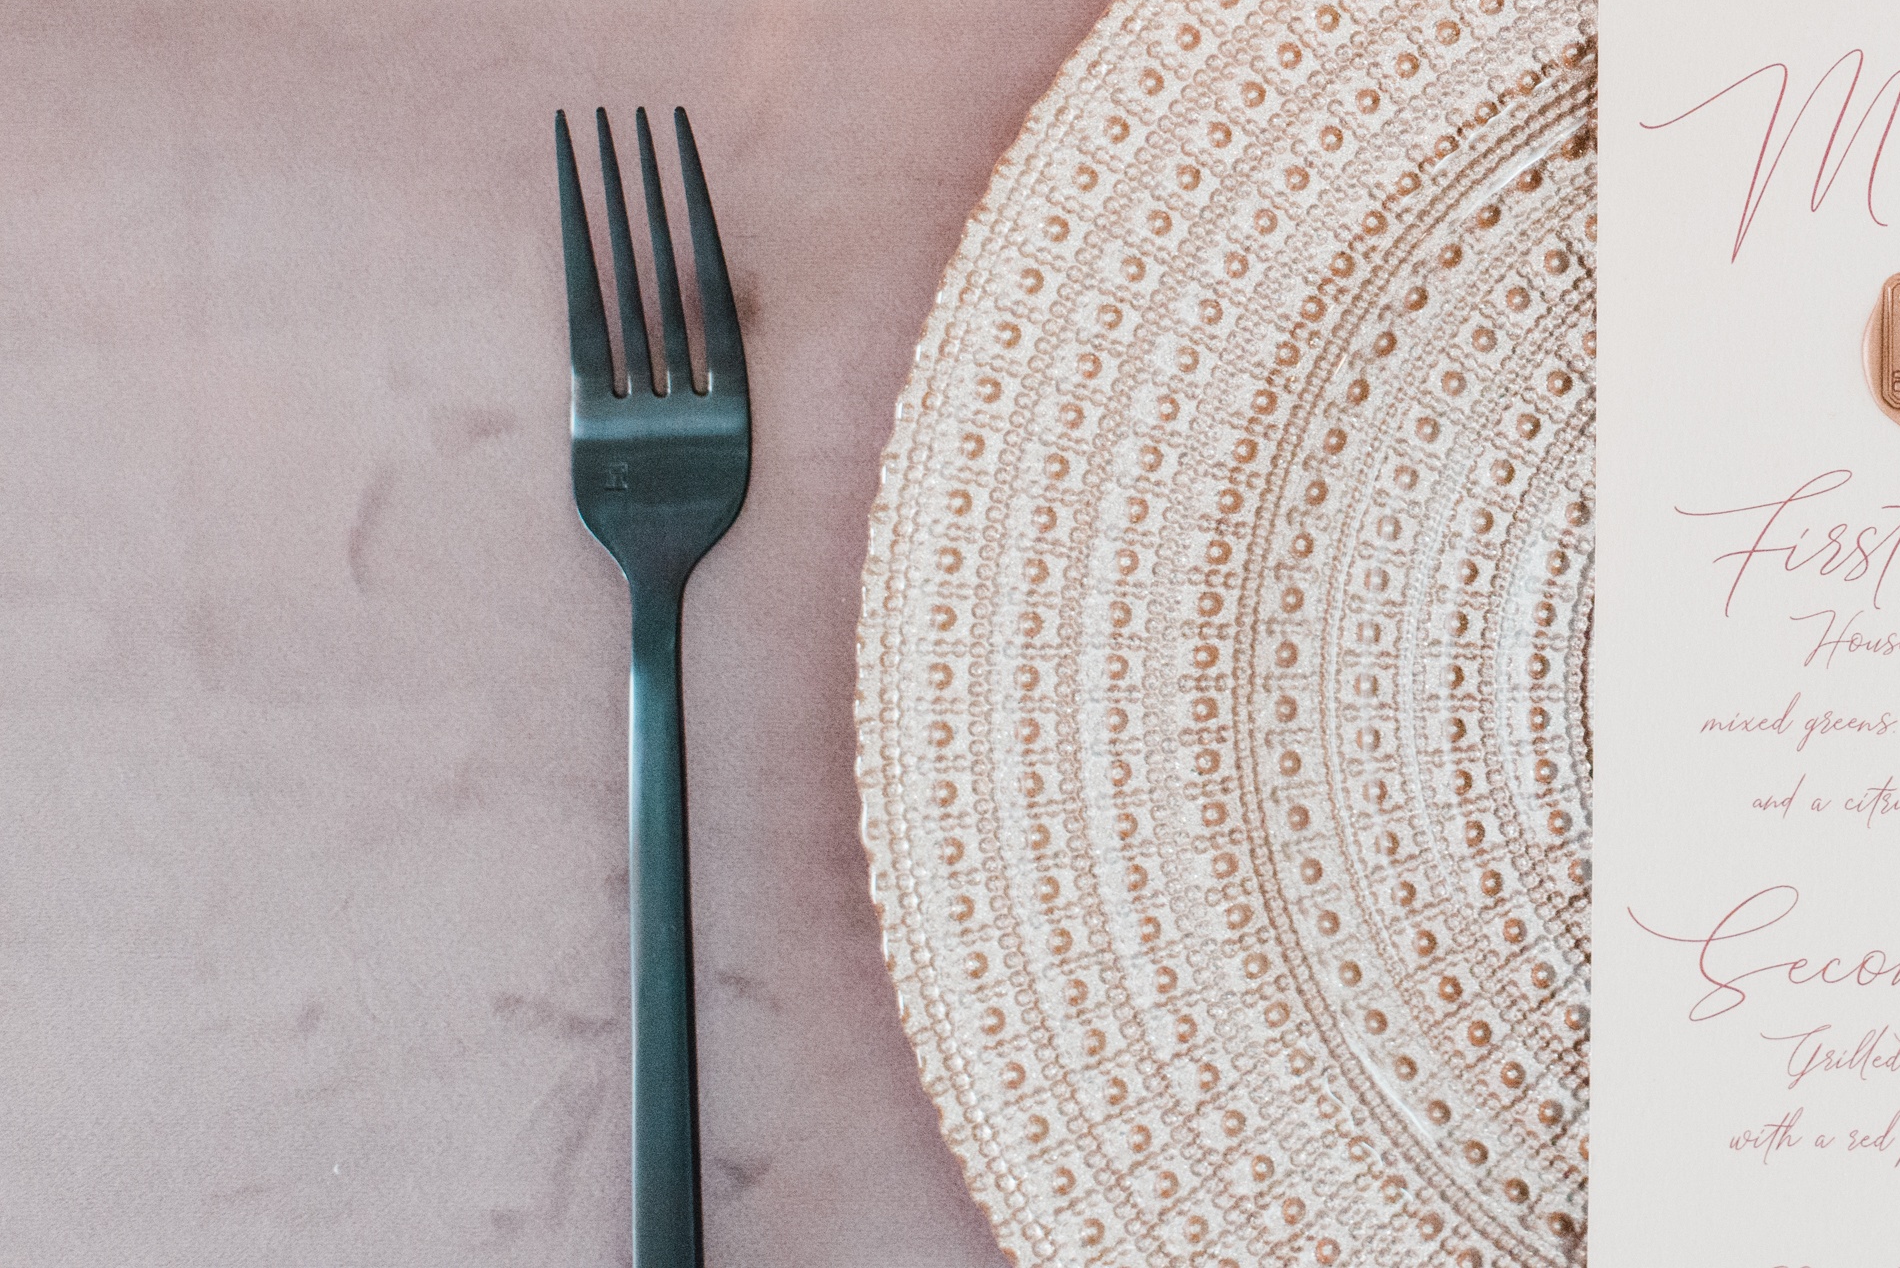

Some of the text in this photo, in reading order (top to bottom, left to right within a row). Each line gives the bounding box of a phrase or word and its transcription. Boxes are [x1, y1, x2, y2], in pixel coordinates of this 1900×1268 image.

[1700, 691, 1802, 736] mixed
[1751, 773, 1808, 819] and
[1810, 797, 1833, 813] a
[1728, 1106, 1804, 1166] with
[1813, 1133, 1836, 1149] a
